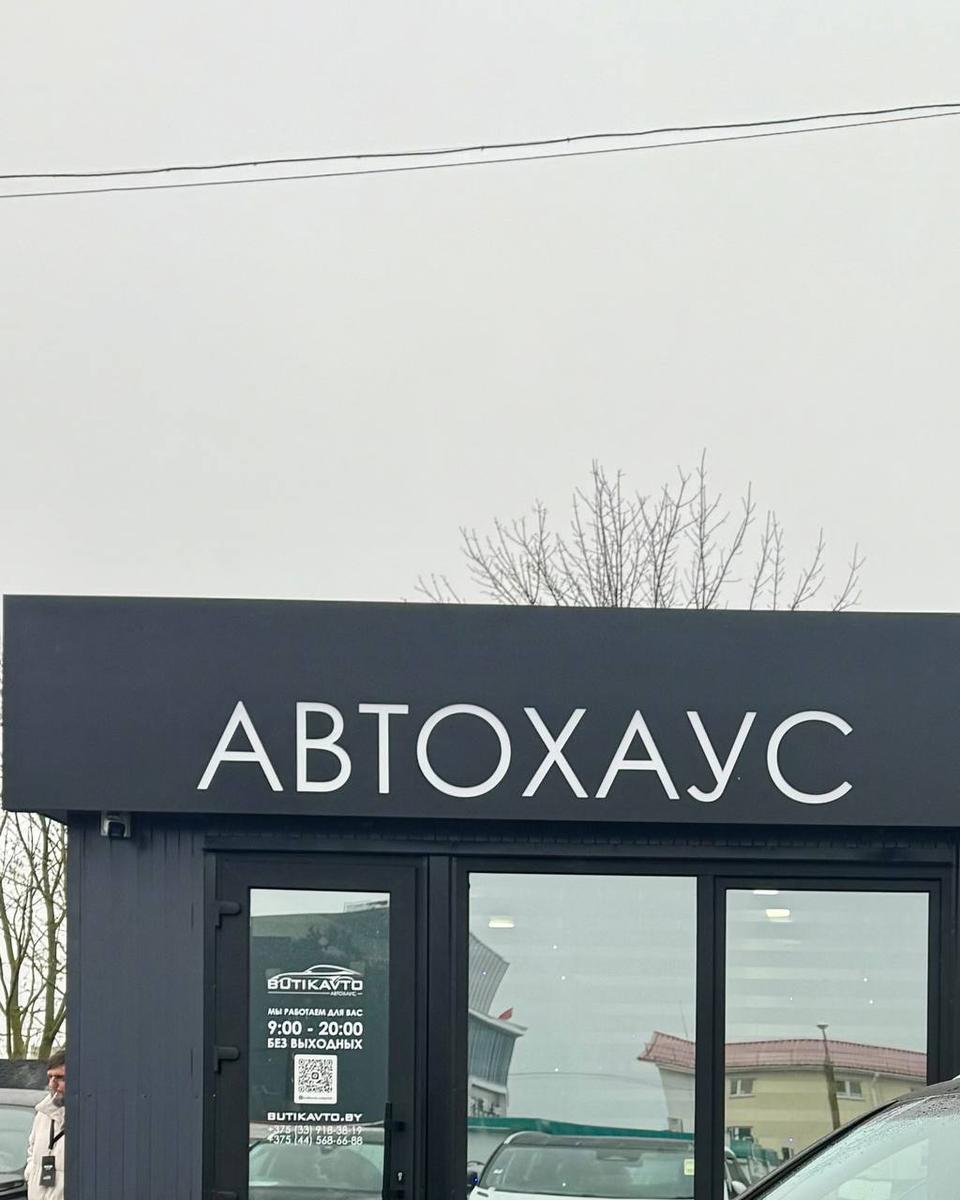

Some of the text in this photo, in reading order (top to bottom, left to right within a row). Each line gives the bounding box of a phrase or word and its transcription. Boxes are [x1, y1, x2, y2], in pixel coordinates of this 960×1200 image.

[197, 701, 853, 804] АВТОХАУС
[267, 979, 363, 990] BUTIKAVTO
[284, 1008, 326, 1016] РАБОТАЕМ
[327, 1009, 344, 1017] ДЛЯ
[346, 1009, 363, 1017] ВАС
[267, 1020, 303, 1035] 9:00
[318, 1021, 363, 1036] 20:00
[267, 1038, 363, 1050] БЕЗ ВЫХОДНЫХ
[267, 1112, 363, 1121] BUTIKAVTO.BY
[295, 1135, 312, 1145] (44)
